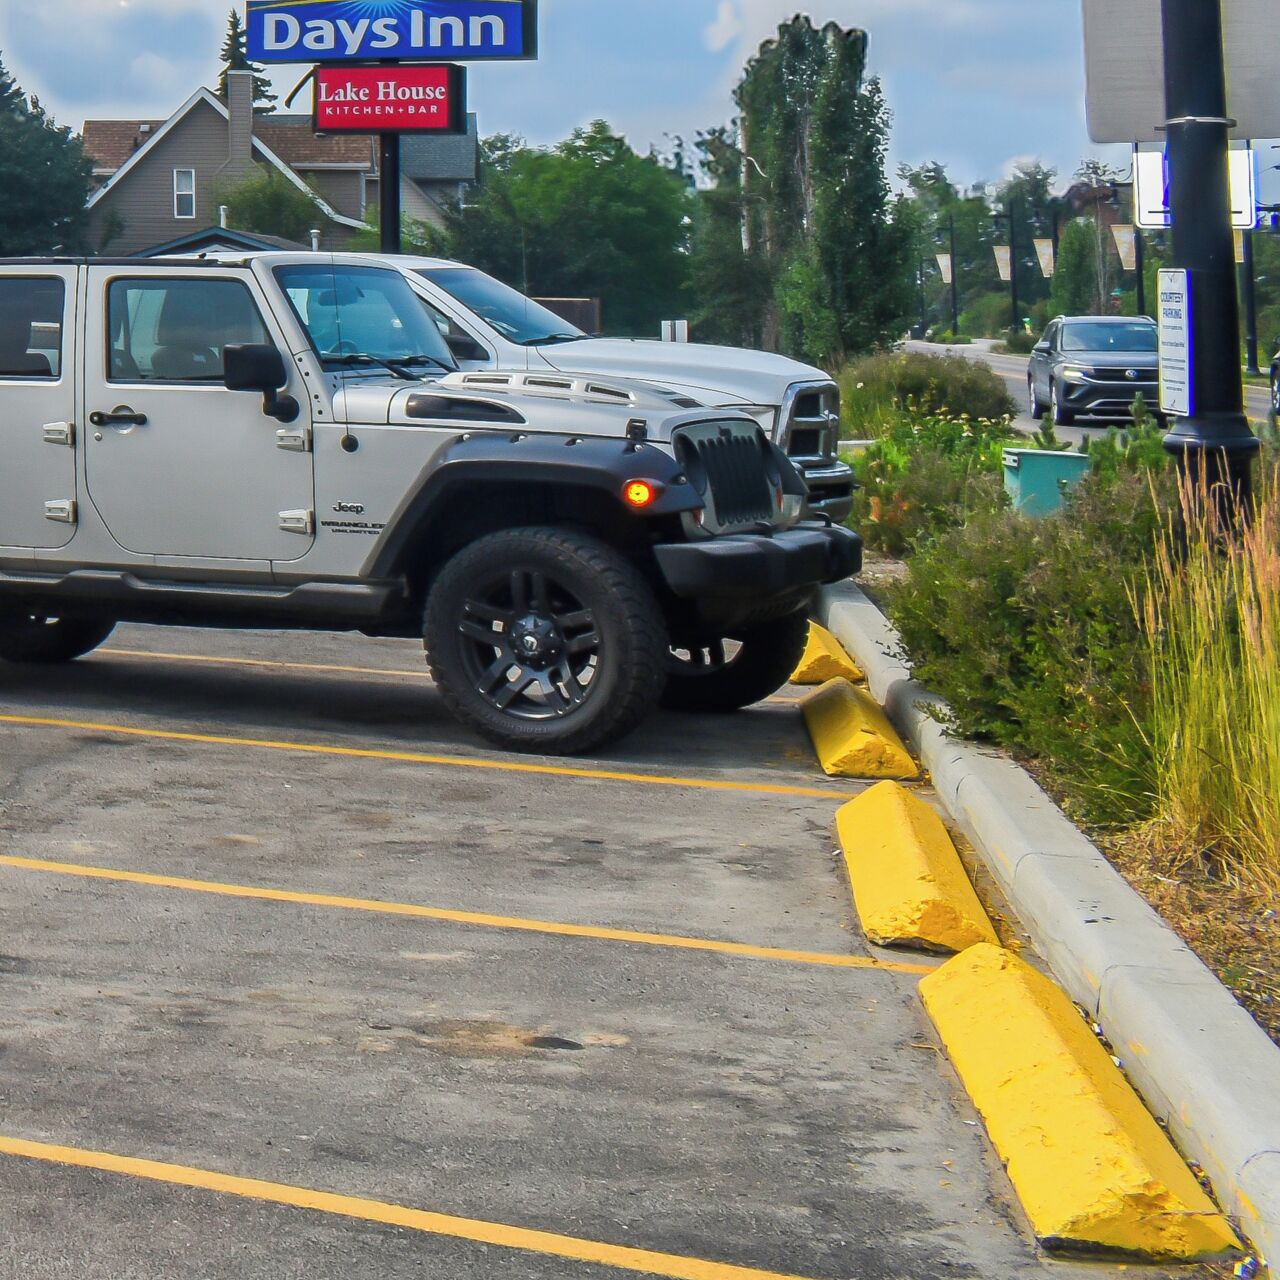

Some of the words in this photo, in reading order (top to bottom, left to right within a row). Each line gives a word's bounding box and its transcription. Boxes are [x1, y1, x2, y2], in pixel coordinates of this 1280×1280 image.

[263, 12, 399, 55] Days
[410, 10, 504, 47] Inn
[319, 82, 370, 101] Lake
[376, 81, 446, 100] House
[325, 105, 439, 115] KITCHEN+BAR
[332, 500, 364, 514] Jeep
